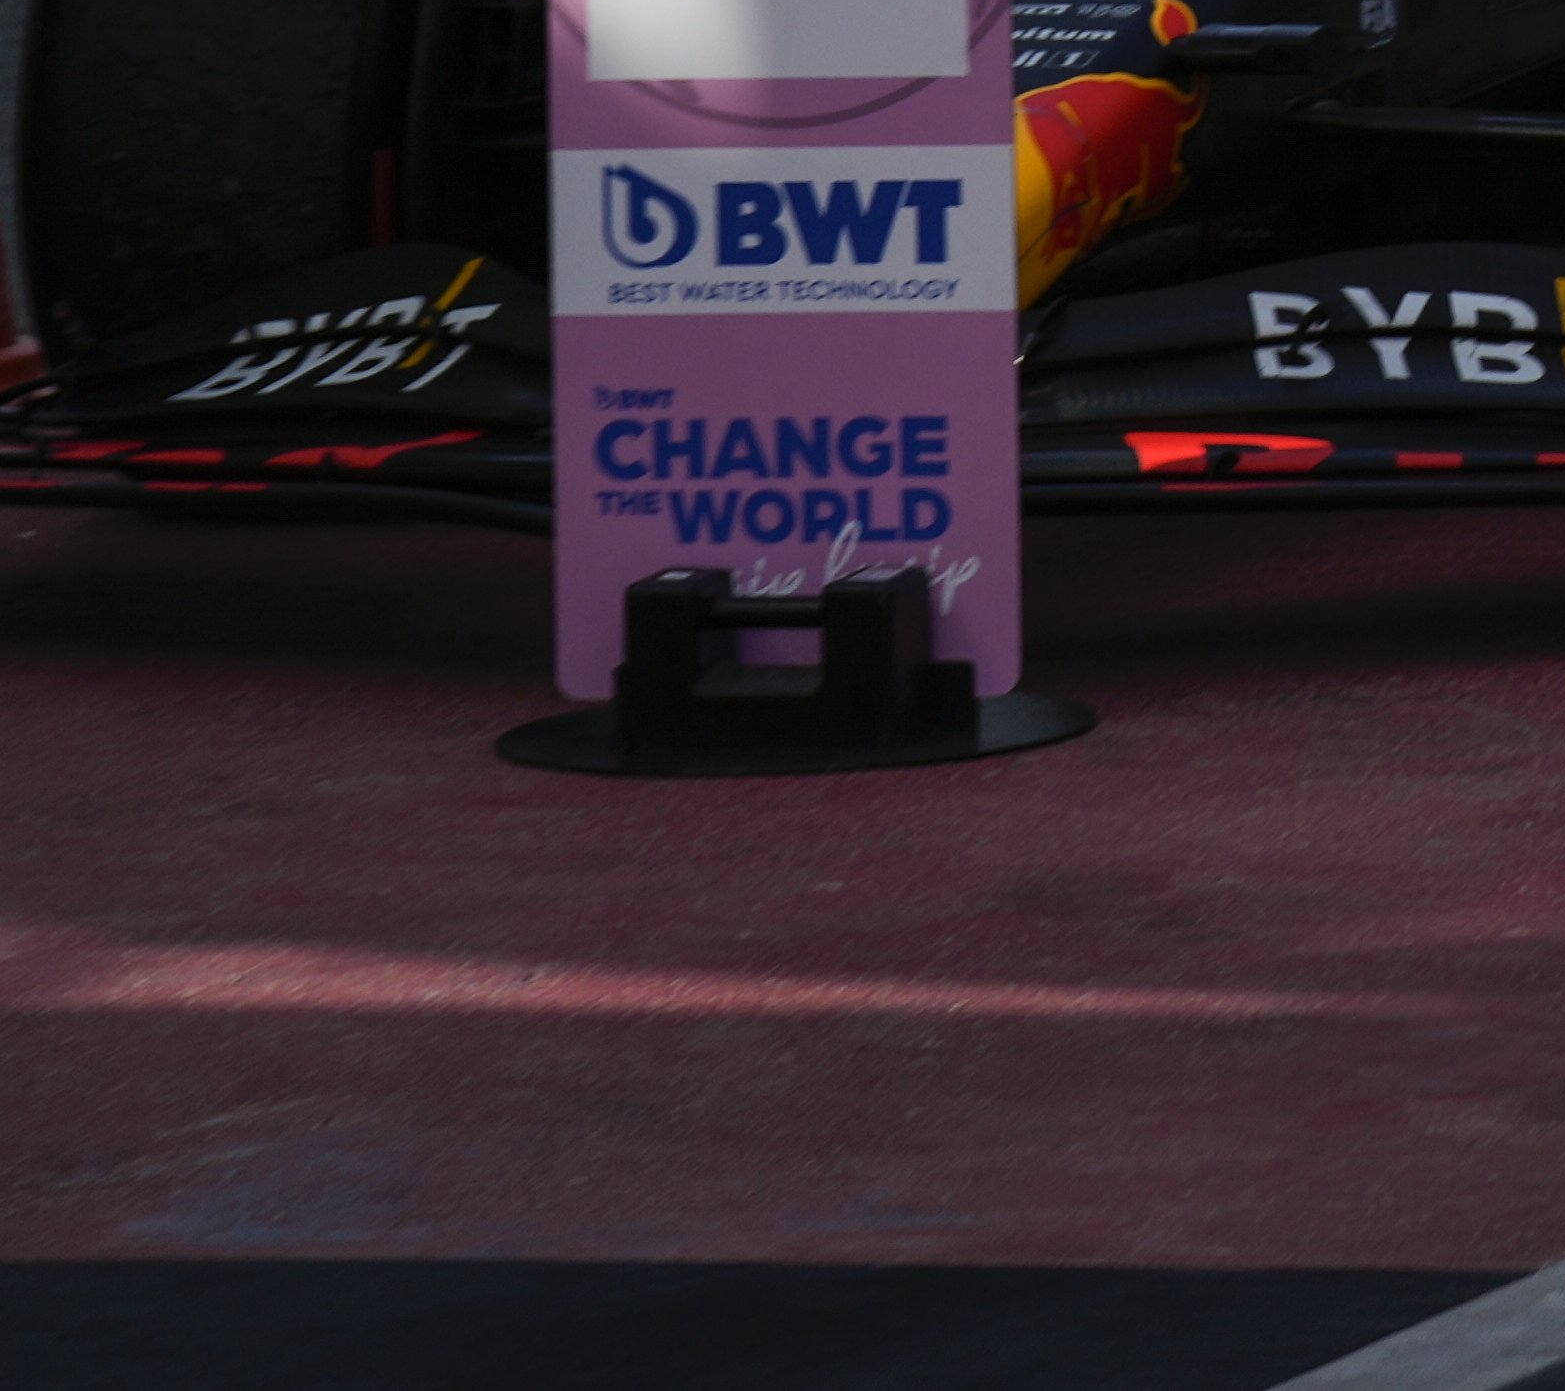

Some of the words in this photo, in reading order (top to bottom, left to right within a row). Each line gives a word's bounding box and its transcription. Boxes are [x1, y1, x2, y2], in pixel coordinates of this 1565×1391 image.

[716, 178, 964, 267] BWT
[607, 281, 675, 305] BEST
[677, 279, 772, 304] WATER
[776, 277, 960, 303] TECHNOLOGY
[615, 387, 675, 409] BWT
[594, 415, 951, 483] CHANGE
[594, 489, 662, 516] THE
[669, 487, 954, 545] WORLD
